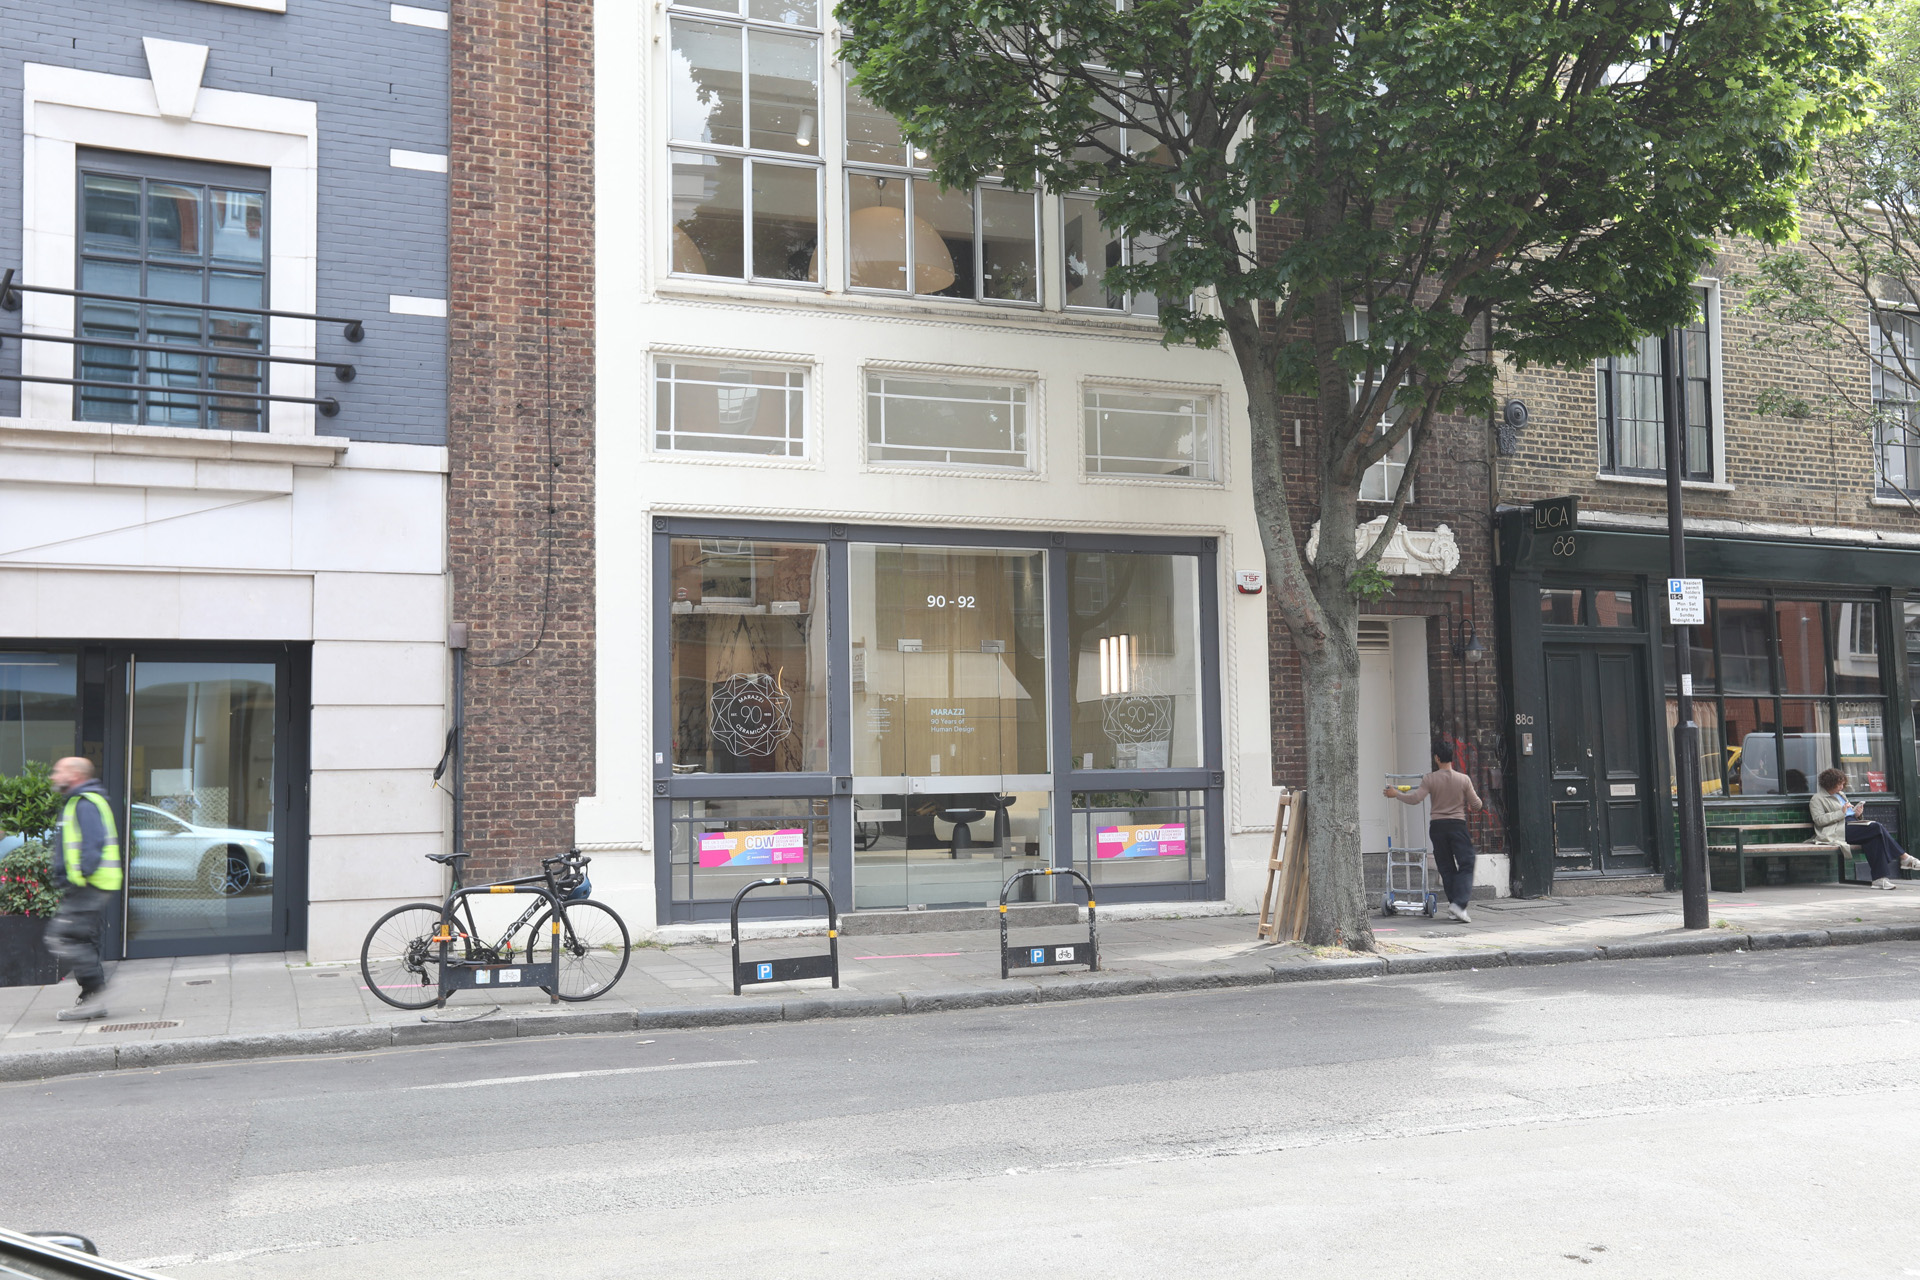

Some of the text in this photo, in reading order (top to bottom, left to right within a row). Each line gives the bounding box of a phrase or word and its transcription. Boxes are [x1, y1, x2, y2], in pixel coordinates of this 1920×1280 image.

[1535, 505, 1569, 529] LUCA
[1552, 535, 1576, 557] 88
[1672, 581, 1680, 592] P
[926, 594, 946, 608] 90
[958, 596, 976, 608] 92
[738, 694, 764, 704] MARAZZI
[740, 705, 762, 724] 90
[930, 708, 965, 716] MARAZZI
[1128, 706, 1147, 724] 90
[1515, 714, 1534, 725] 88a
[735, 723, 768, 735] CERAMICHE
[746, 836, 774, 848] CDW
[1136, 830, 1160, 842] CDW
[1033, 950, 1042, 962] P
[760, 966, 770, 978] P
